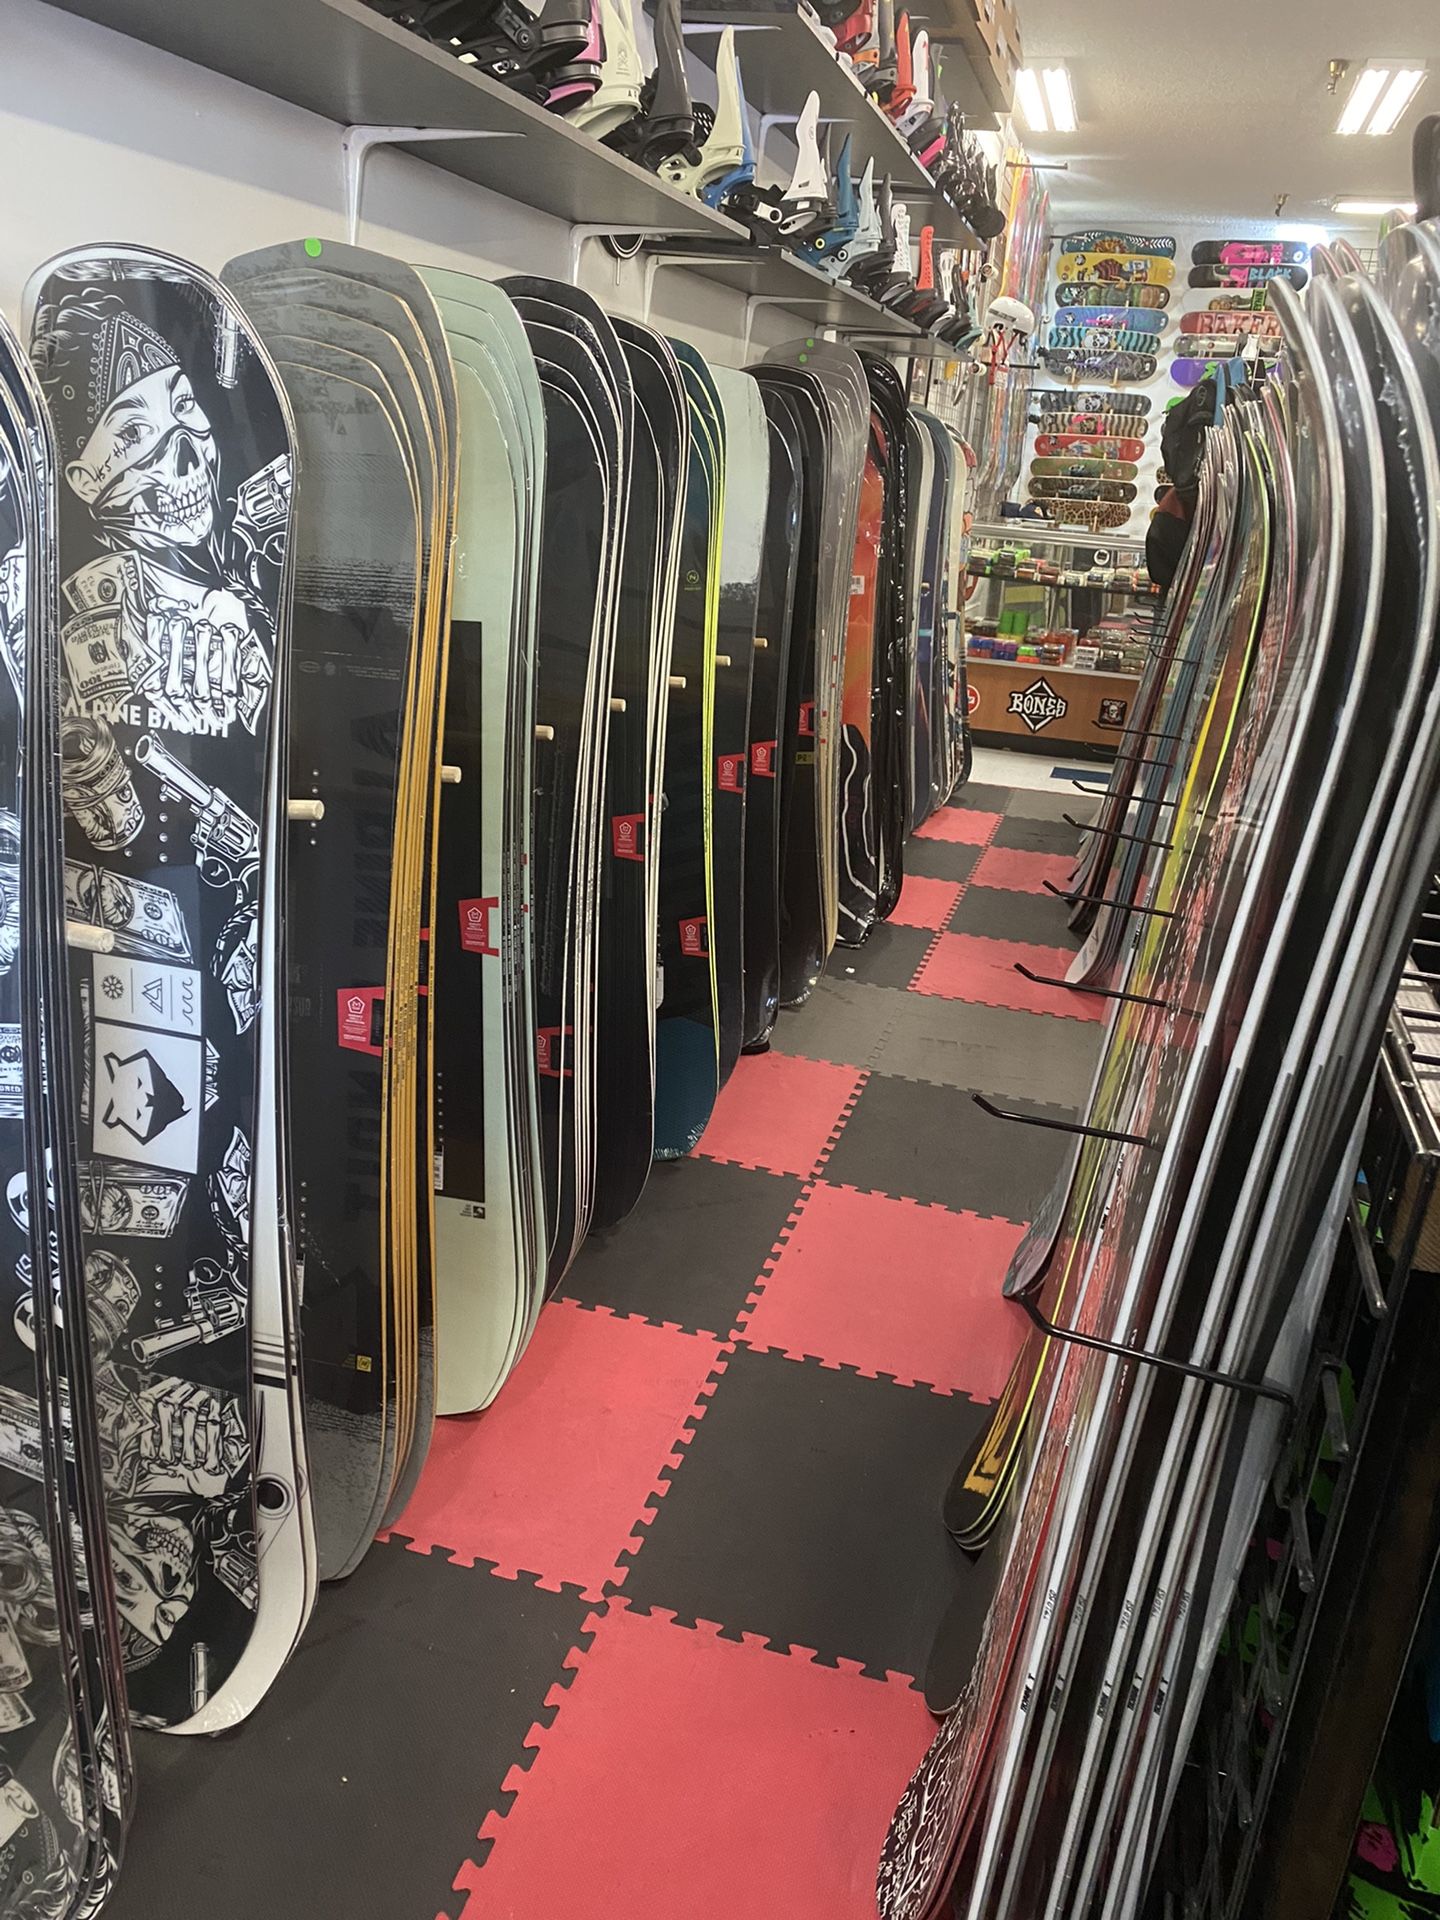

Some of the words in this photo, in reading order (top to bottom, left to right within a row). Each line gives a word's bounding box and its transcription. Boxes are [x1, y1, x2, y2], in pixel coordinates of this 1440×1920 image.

[1249, 267, 1292, 280] BLACK
[1199, 314, 1281, 334] BAKER
[1009, 693, 1066, 718] BONES
[147, 705, 232, 739] BADIT
